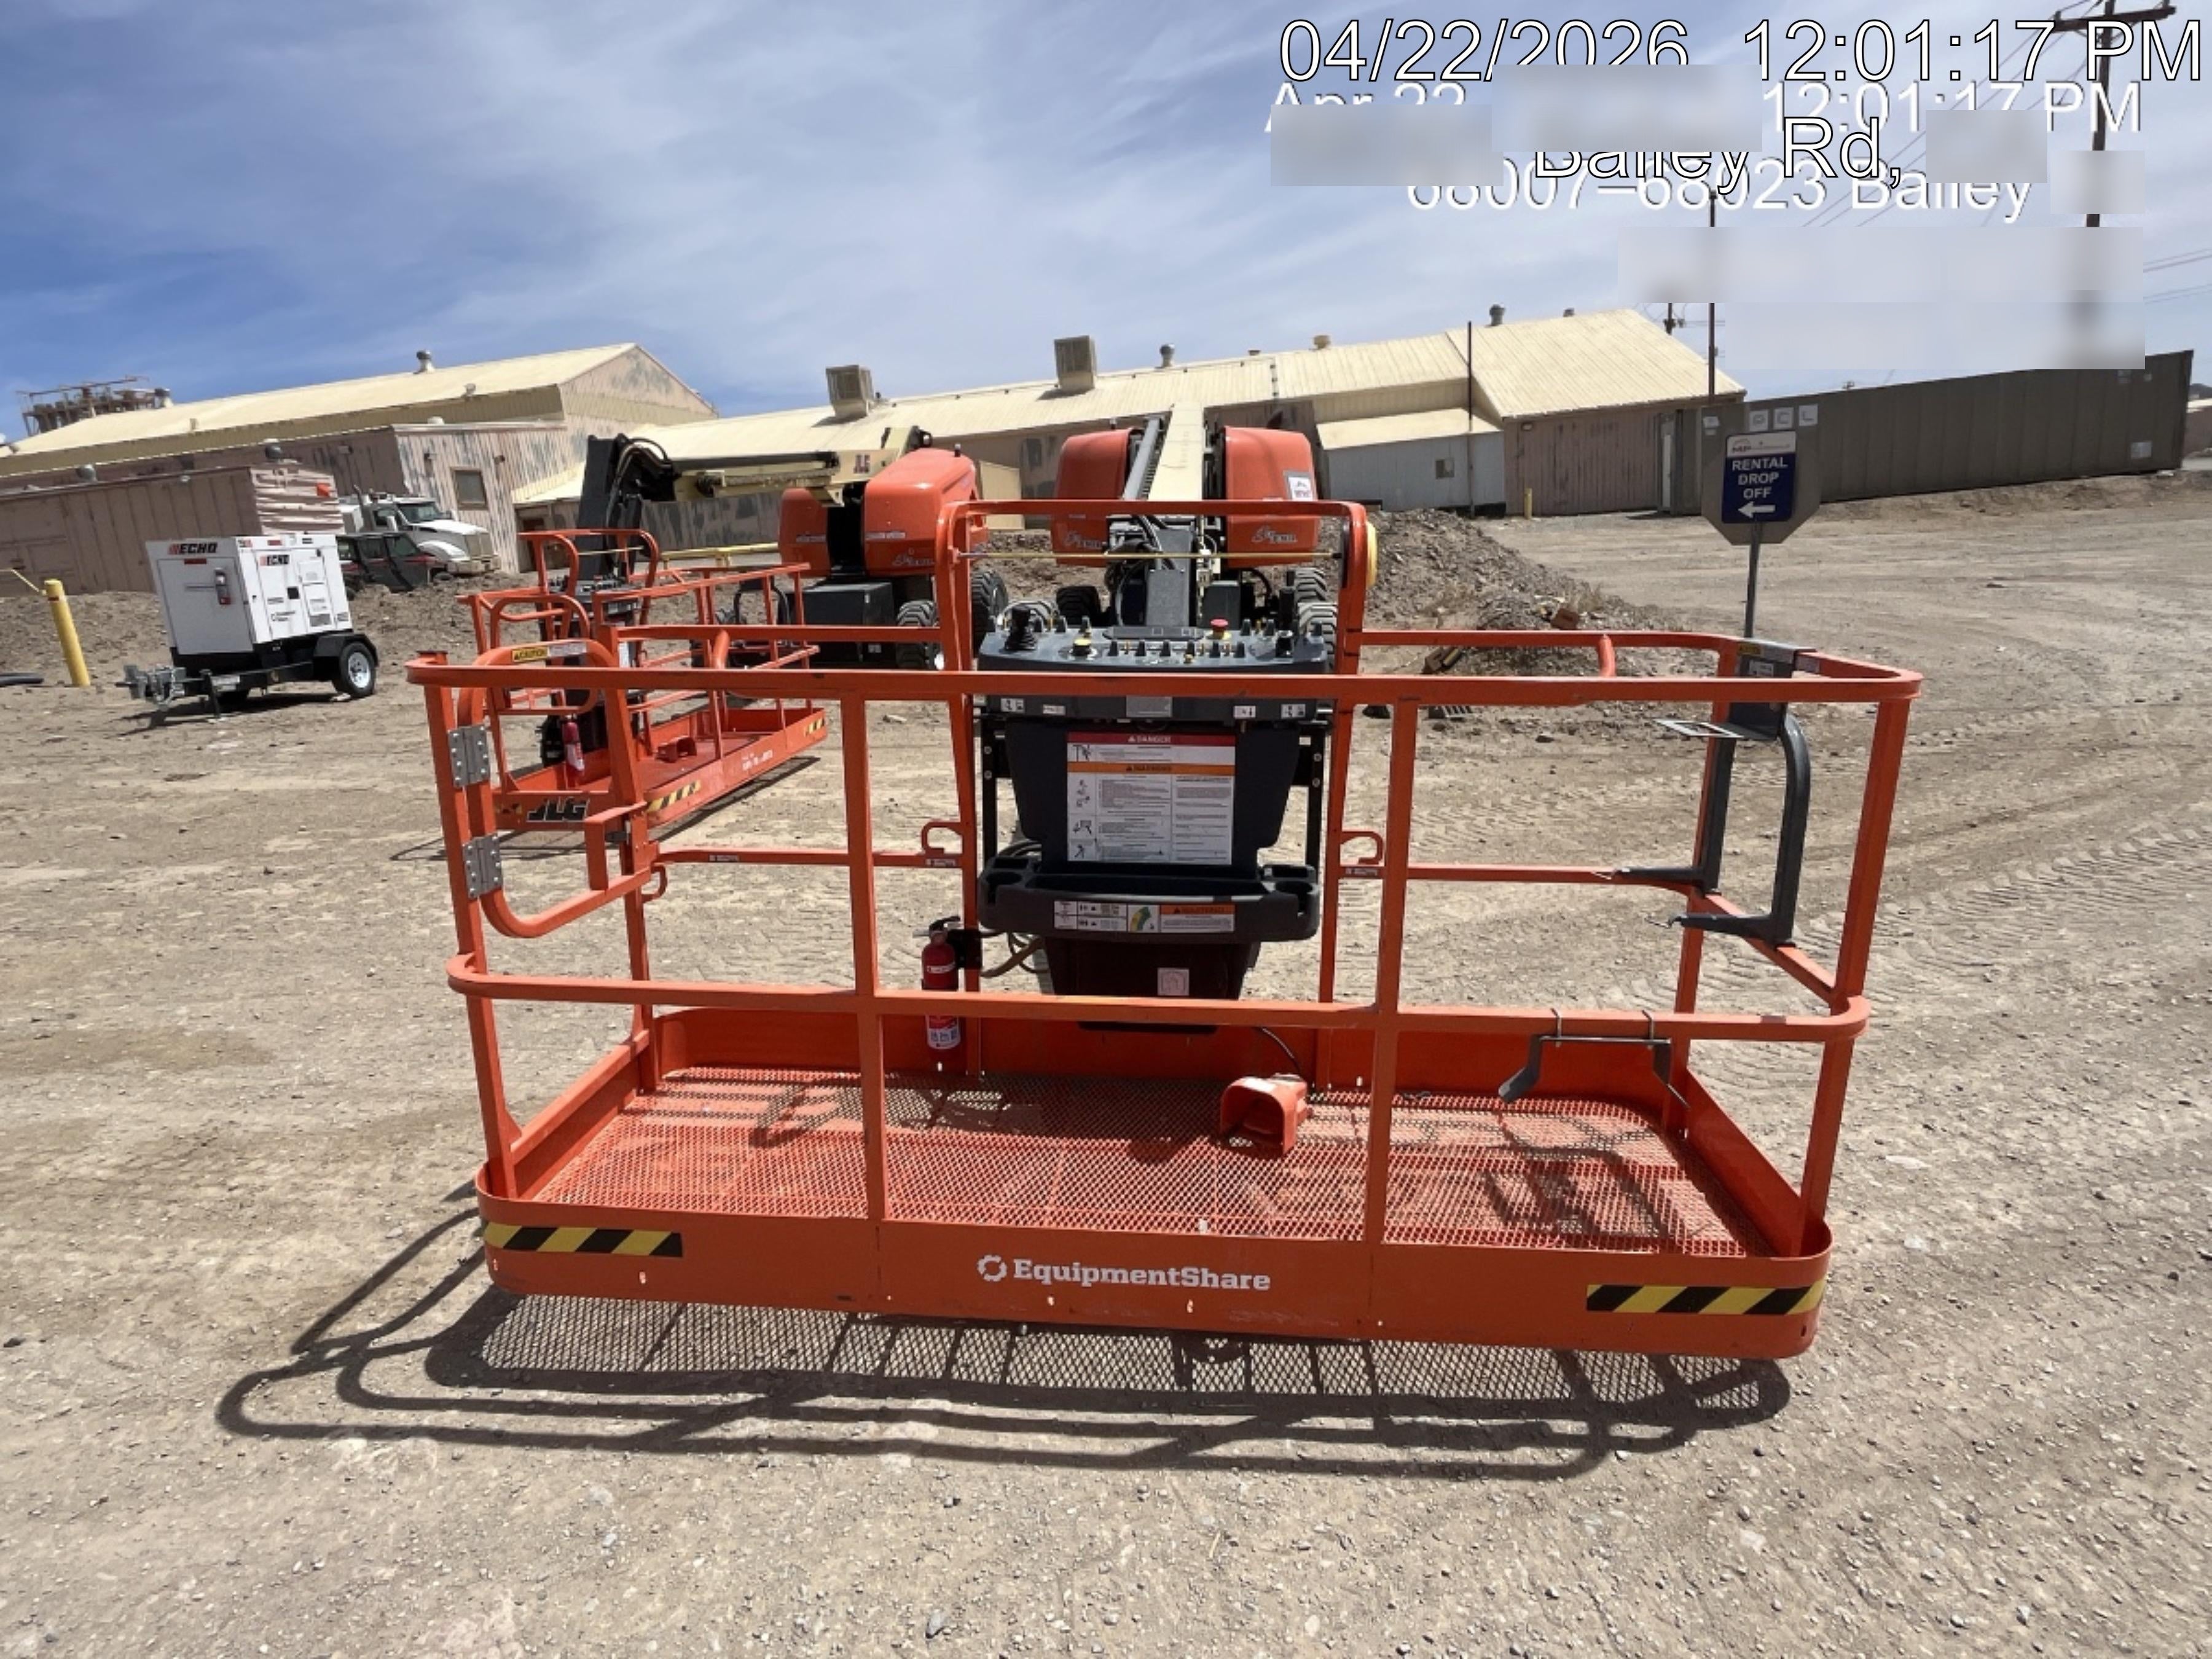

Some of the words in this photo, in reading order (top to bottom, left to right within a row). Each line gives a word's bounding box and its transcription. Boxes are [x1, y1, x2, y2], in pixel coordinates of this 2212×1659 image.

[1732, 457, 1789, 472] RENTAL
[1738, 472, 1779, 485] DROP
[1743, 486, 1772, 500] OFF
[180, 543, 218, 554] ECHO
[1013, 1258, 1271, 1290] EquipmentShare
